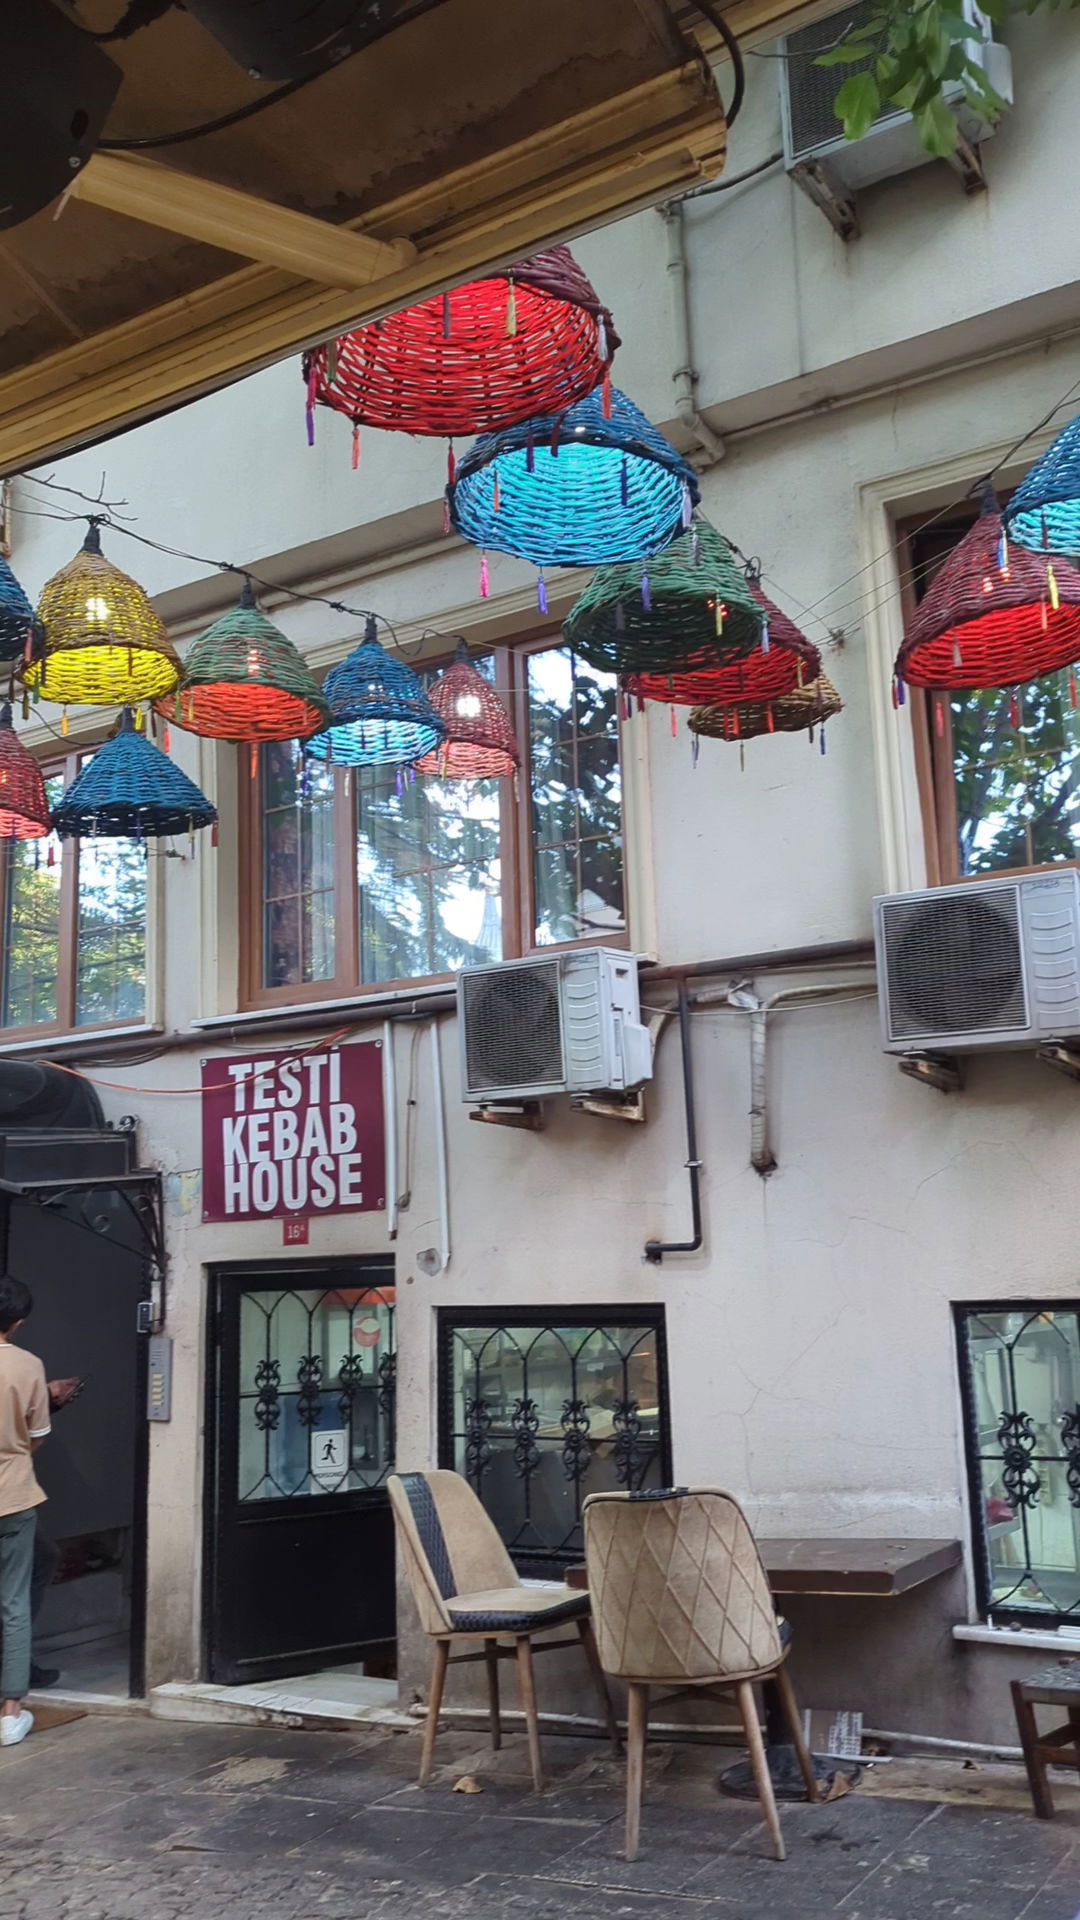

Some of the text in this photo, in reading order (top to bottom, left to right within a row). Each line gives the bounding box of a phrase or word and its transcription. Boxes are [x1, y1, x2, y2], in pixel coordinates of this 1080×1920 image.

[228, 1053, 340, 1112] TESTI
[222, 1103, 357, 1165] KEBAB
[224, 1153, 363, 1214] HOUSE
